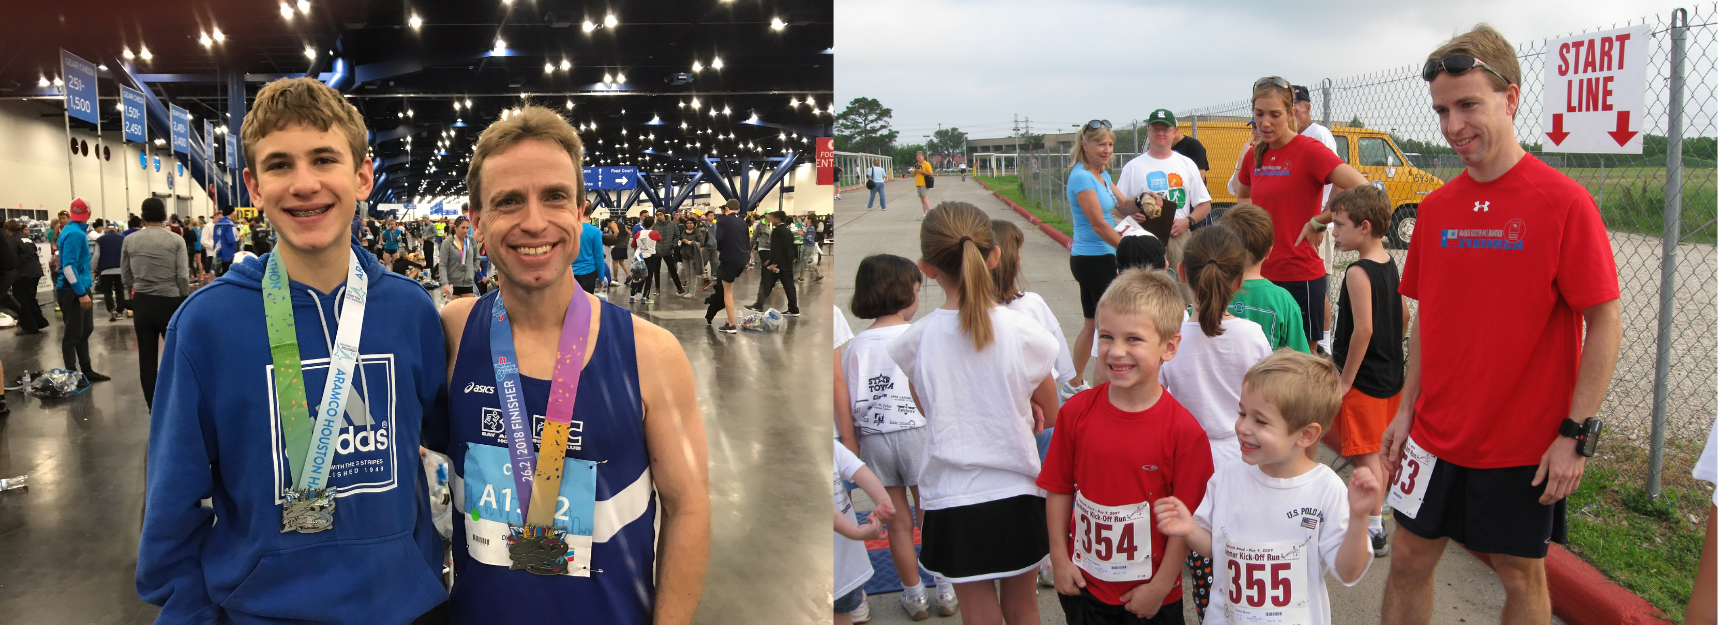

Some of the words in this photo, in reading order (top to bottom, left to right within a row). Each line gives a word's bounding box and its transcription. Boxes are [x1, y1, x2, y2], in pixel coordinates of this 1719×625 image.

[1557, 33, 1631, 76] START
[68, 75, 85, 91] 251-
[69, 95, 91, 113] 1,500
[1566, 76, 1614, 113] LINE
[125, 121, 142, 135] 2,450
[1458, 238, 1524, 250] FINISHER
[327, 367, 346, 417] ARAMCO
[503, 380, 523, 430] FINISHER
[310, 418, 335, 475] HOUSTON
[514, 431, 528, 455] 2018
[519, 461, 534, 482] 26.2
[1090, 511, 1113, 523] Kick-Off
[1286, 509, 1299, 519] U.S.
[1301, 507, 1318, 516] POLO
[1081, 513, 1138, 561] 354
[1239, 552, 1265, 561] Kick-Off
[1267, 553, 1280, 561] Run
[1227, 559, 1292, 607] 355
